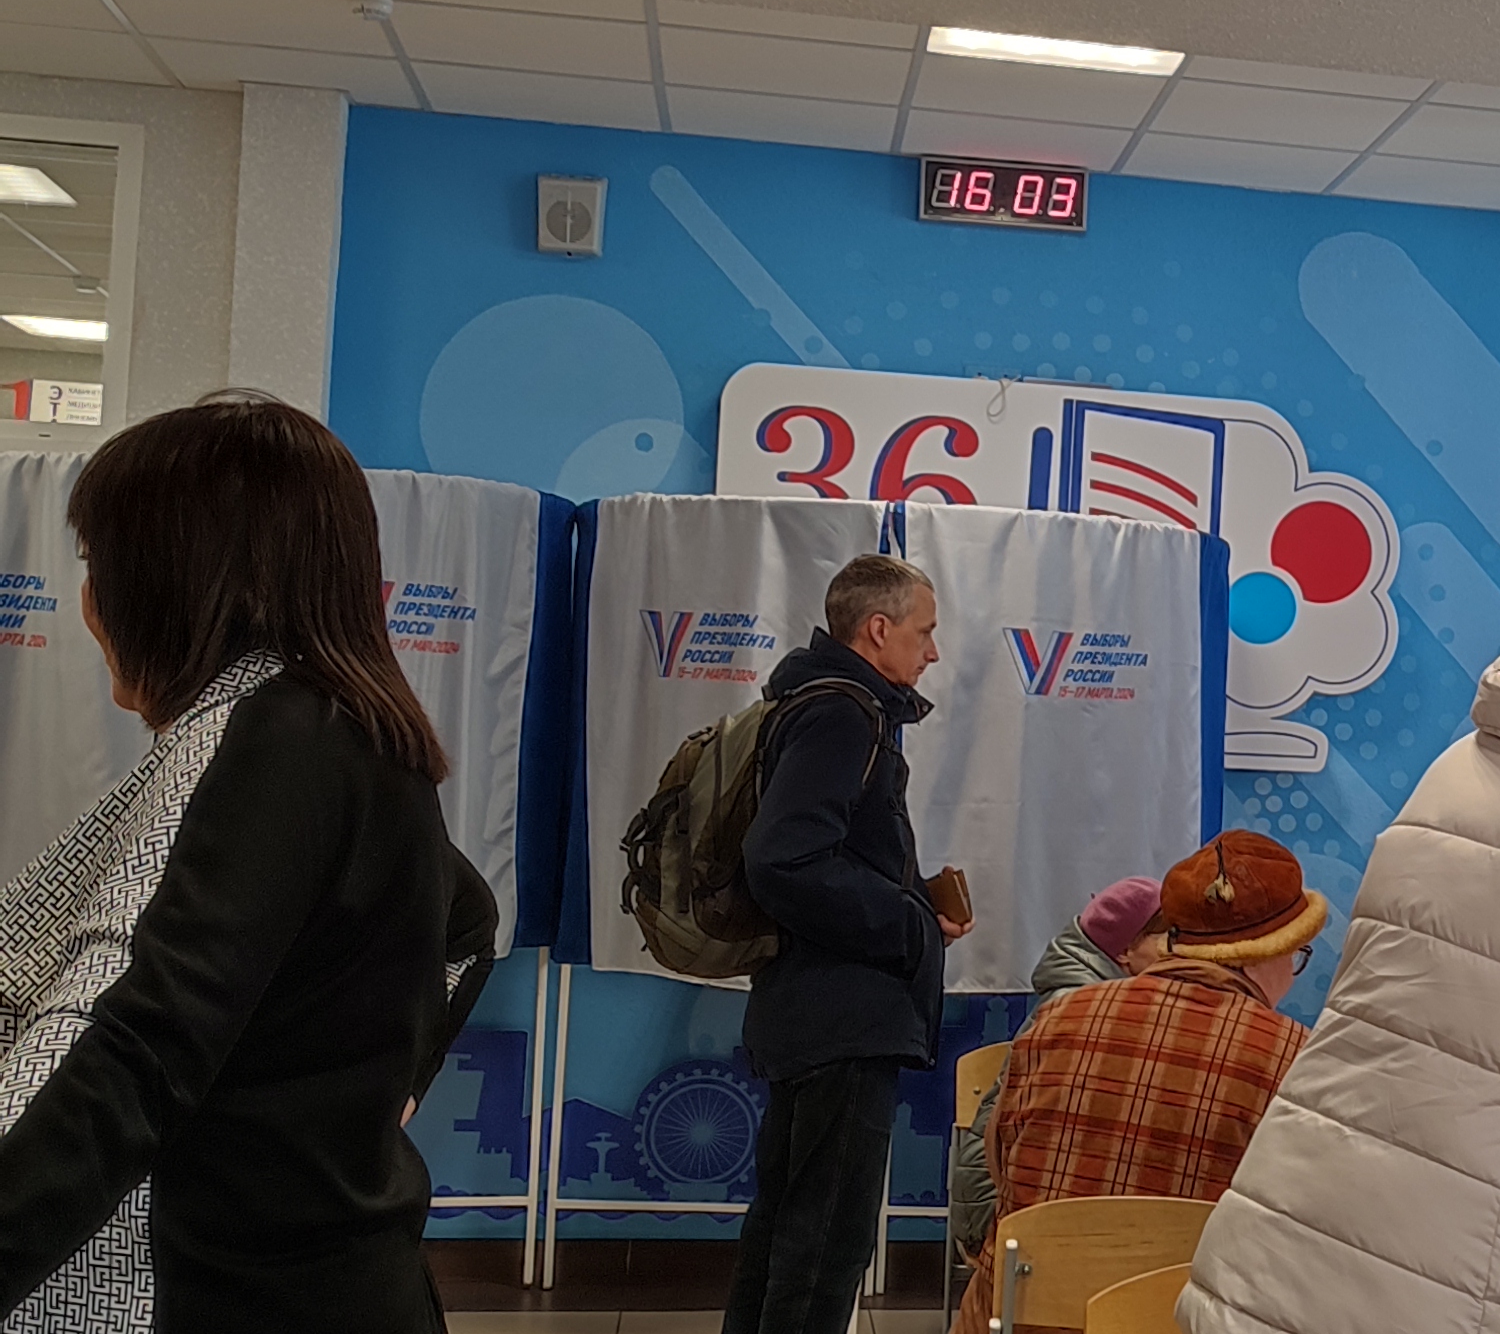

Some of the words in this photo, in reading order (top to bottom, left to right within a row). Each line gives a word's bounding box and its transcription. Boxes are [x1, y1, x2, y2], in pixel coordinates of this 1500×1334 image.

[1012, 174, 1077, 218] 03
[0, 593, 58, 613] ЗИДЕНТА
[698, 612, 759, 629] ВЫБОРЫ
[689, 631, 777, 650] ПРЕЗИДЕНТА
[1079, 632, 1132, 648] ВЫБОРЫ
[681, 649, 735, 664] РОССИИ
[1071, 650, 1149, 667] ПРЕЗИДЕНТА
[1062, 668, 1116, 683] РОССИИ
